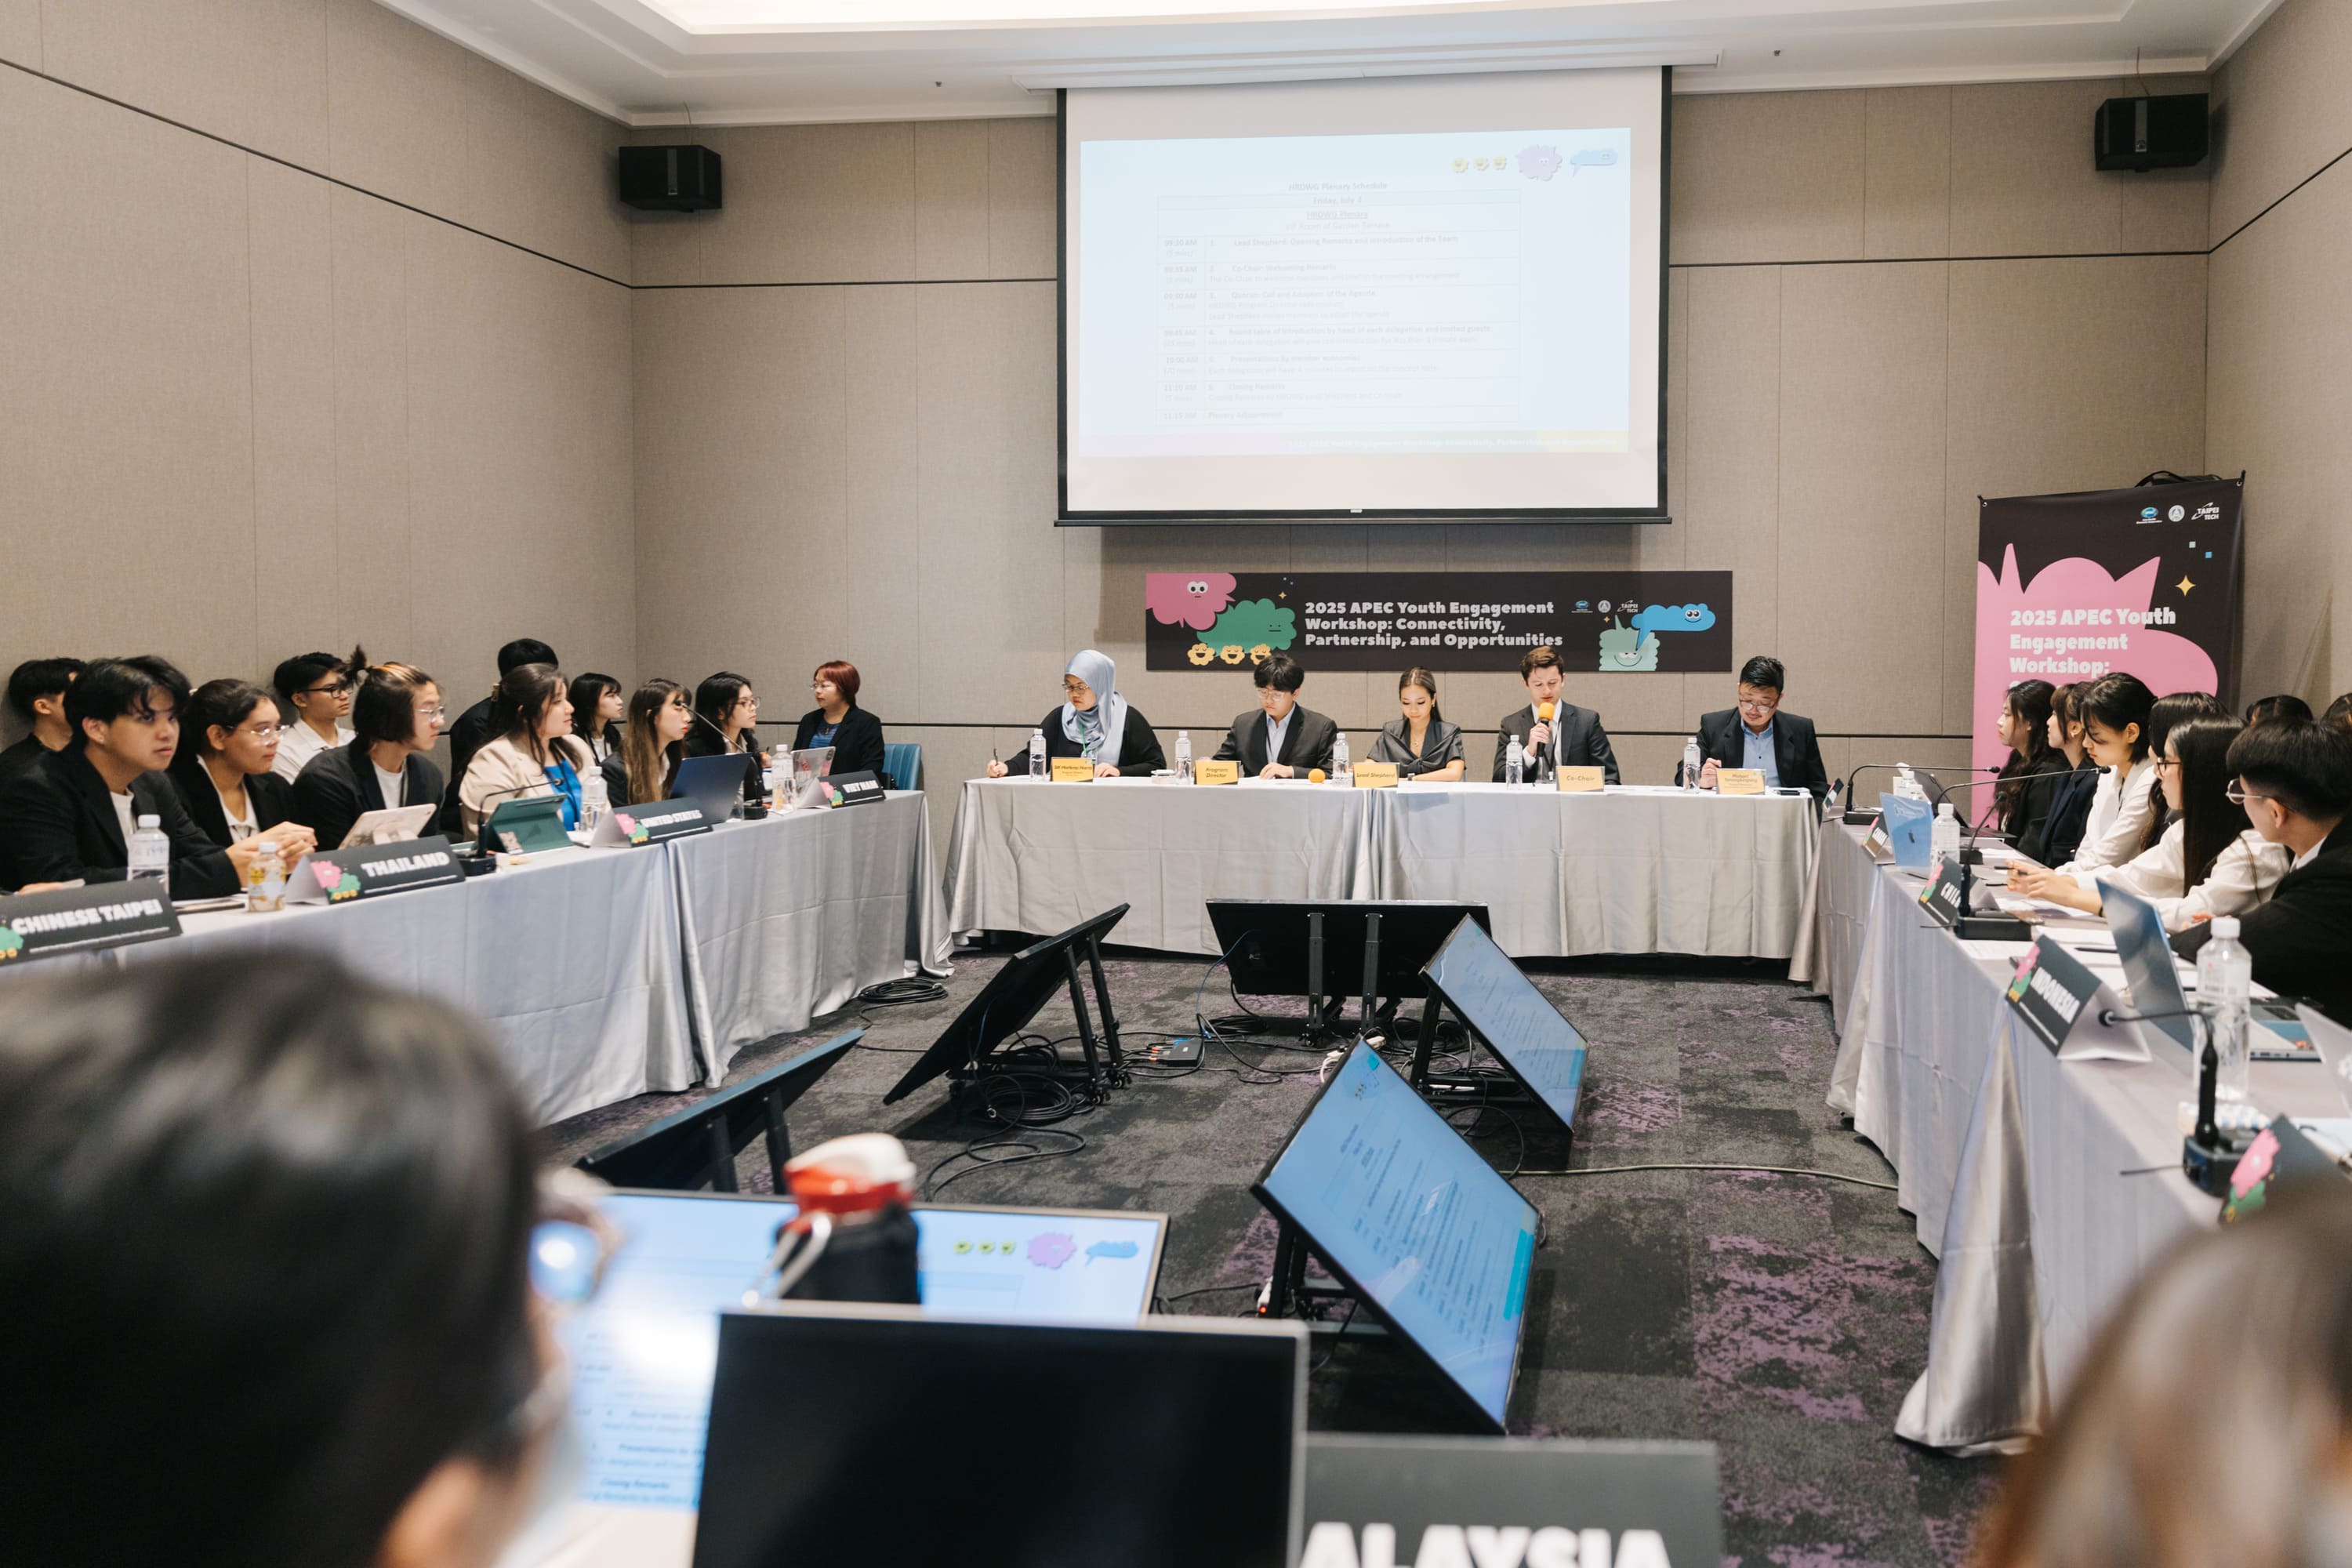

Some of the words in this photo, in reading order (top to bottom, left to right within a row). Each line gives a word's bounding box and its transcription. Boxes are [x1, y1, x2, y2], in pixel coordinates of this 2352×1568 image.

[1322, 182, 1350, 191] Plenary
[1352, 181, 1388, 190] Schedule
[1234, 238, 1250, 246] Lead
[1290, 238, 1320, 247] Opening
[2197, 506, 2220, 515] TAIPEI
[1305, 601, 1346, 614] 2025
[1349, 601, 1394, 614] APEC
[1397, 601, 1446, 614] Youth
[1450, 601, 1554, 617] Engagement
[2010, 610, 2056, 626] 2025
[2060, 608, 2113, 626] APEC
[2116, 606, 2176, 625] Youth
[1305, 617, 1392, 633] Workshop:
[1396, 617, 1505, 633] Connectivity,
[1305, 633, 1406, 649] Partnership,
[1410, 633, 1440, 646] and
[1444, 633, 1563, 649] Opportunities
[2009, 633, 2129, 655] Engagement
[2009, 656, 2110, 679] Workshop:
[361, 851, 450, 877] THAILAND
[11, 907, 102, 935] CHINESE
[98, 898, 164, 922] TAIPEI
[2030, 966, 2081, 1024] INDONESIA
[1299, 1521, 1671, 1568] ALAYSIA
